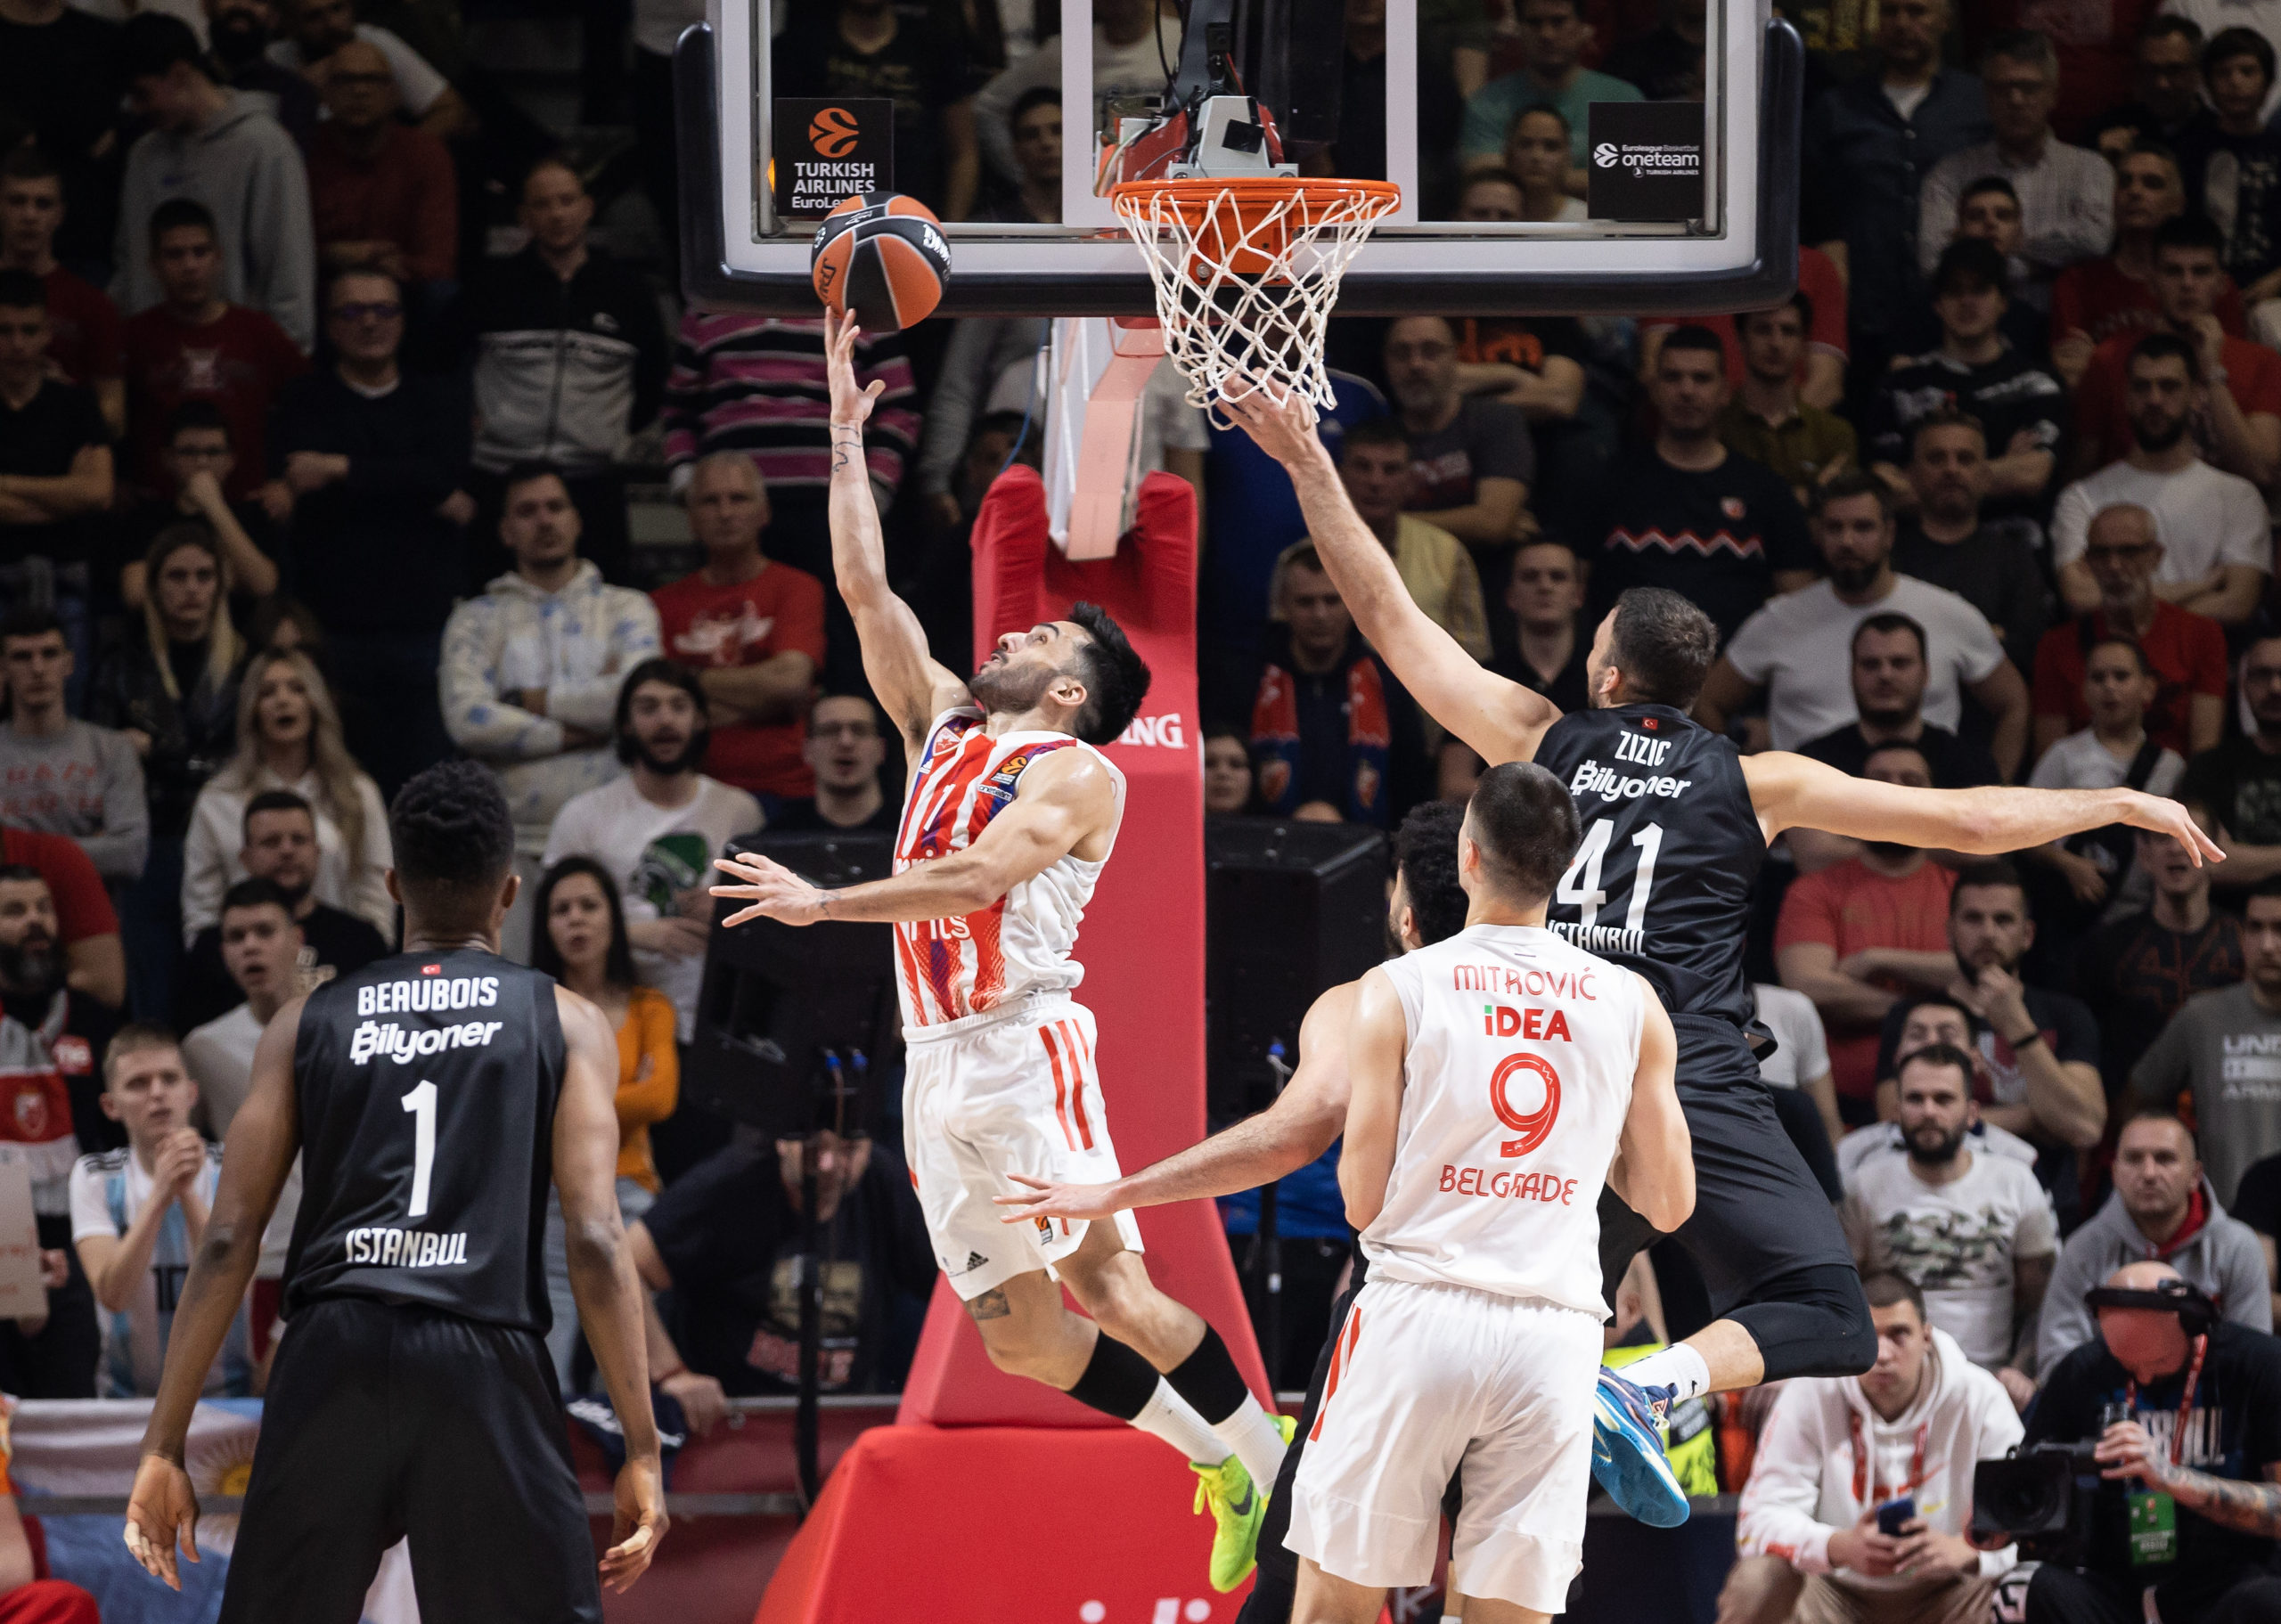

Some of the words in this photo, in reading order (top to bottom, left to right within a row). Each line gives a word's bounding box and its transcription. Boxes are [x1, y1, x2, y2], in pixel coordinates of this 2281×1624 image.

[794, 163, 874, 177] TURKISH
[1622, 152, 1699, 167] oneteam
[793, 179, 875, 193] AIRLINES
[1120, 713, 1184, 749] ING
[1615, 730, 1672, 767] ZIZIC
[1570, 759, 1692, 803] Bilyoner
[1557, 818, 1664, 931] 41
[357, 976, 500, 1016] BEAUBOIS
[1453, 965, 1597, 1001] MITROVIĆ
[349, 1020, 503, 1065] Bilyoner
[1490, 1052, 1561, 1158] 9
[401, 1079, 437, 1217] 1
[1439, 1164, 1579, 1206] BELGRADE
[345, 1227, 468, 1268] ISTANBUL
